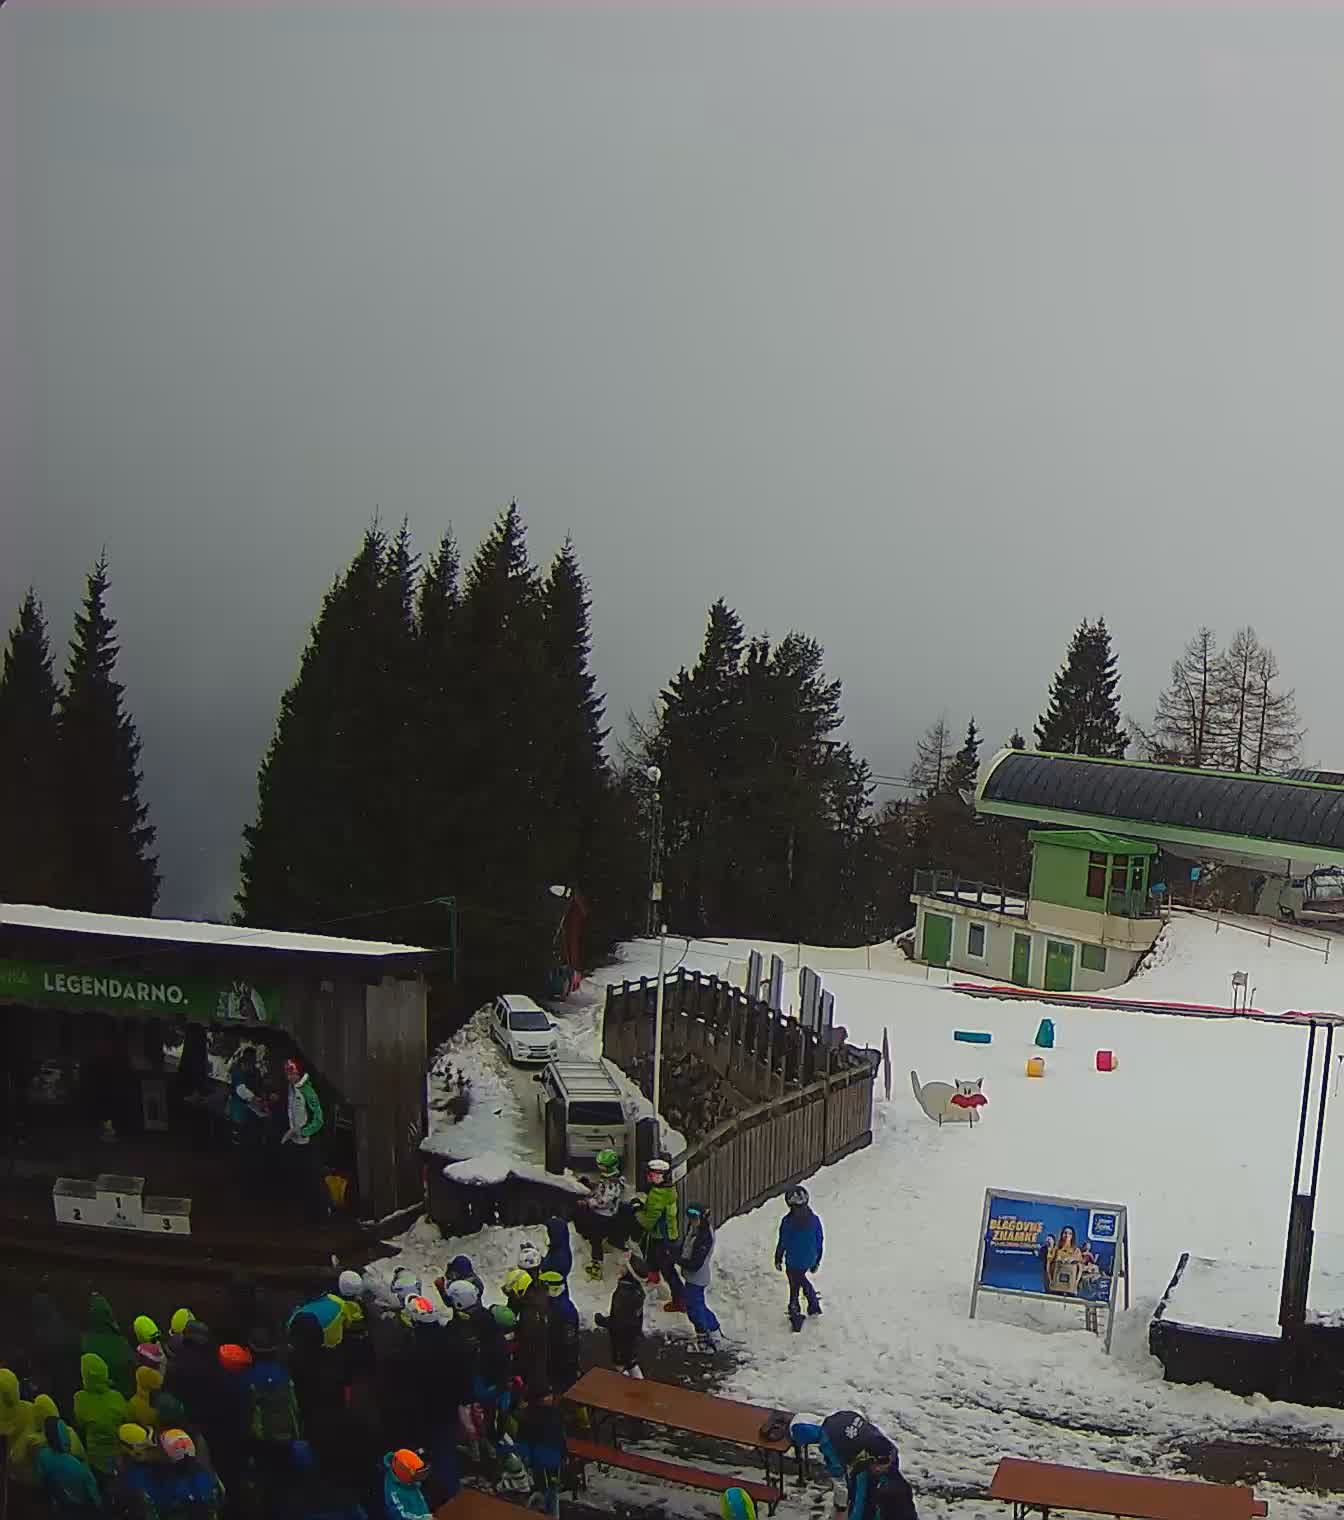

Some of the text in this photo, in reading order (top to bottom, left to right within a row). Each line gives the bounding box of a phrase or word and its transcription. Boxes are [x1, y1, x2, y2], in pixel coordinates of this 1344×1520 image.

[43, 971, 190, 1005] LEGENDARNO.
[115, 1197, 122, 1209] 1
[72, 1208, 82, 1221] 2
[162, 1218, 172, 1231] 3
